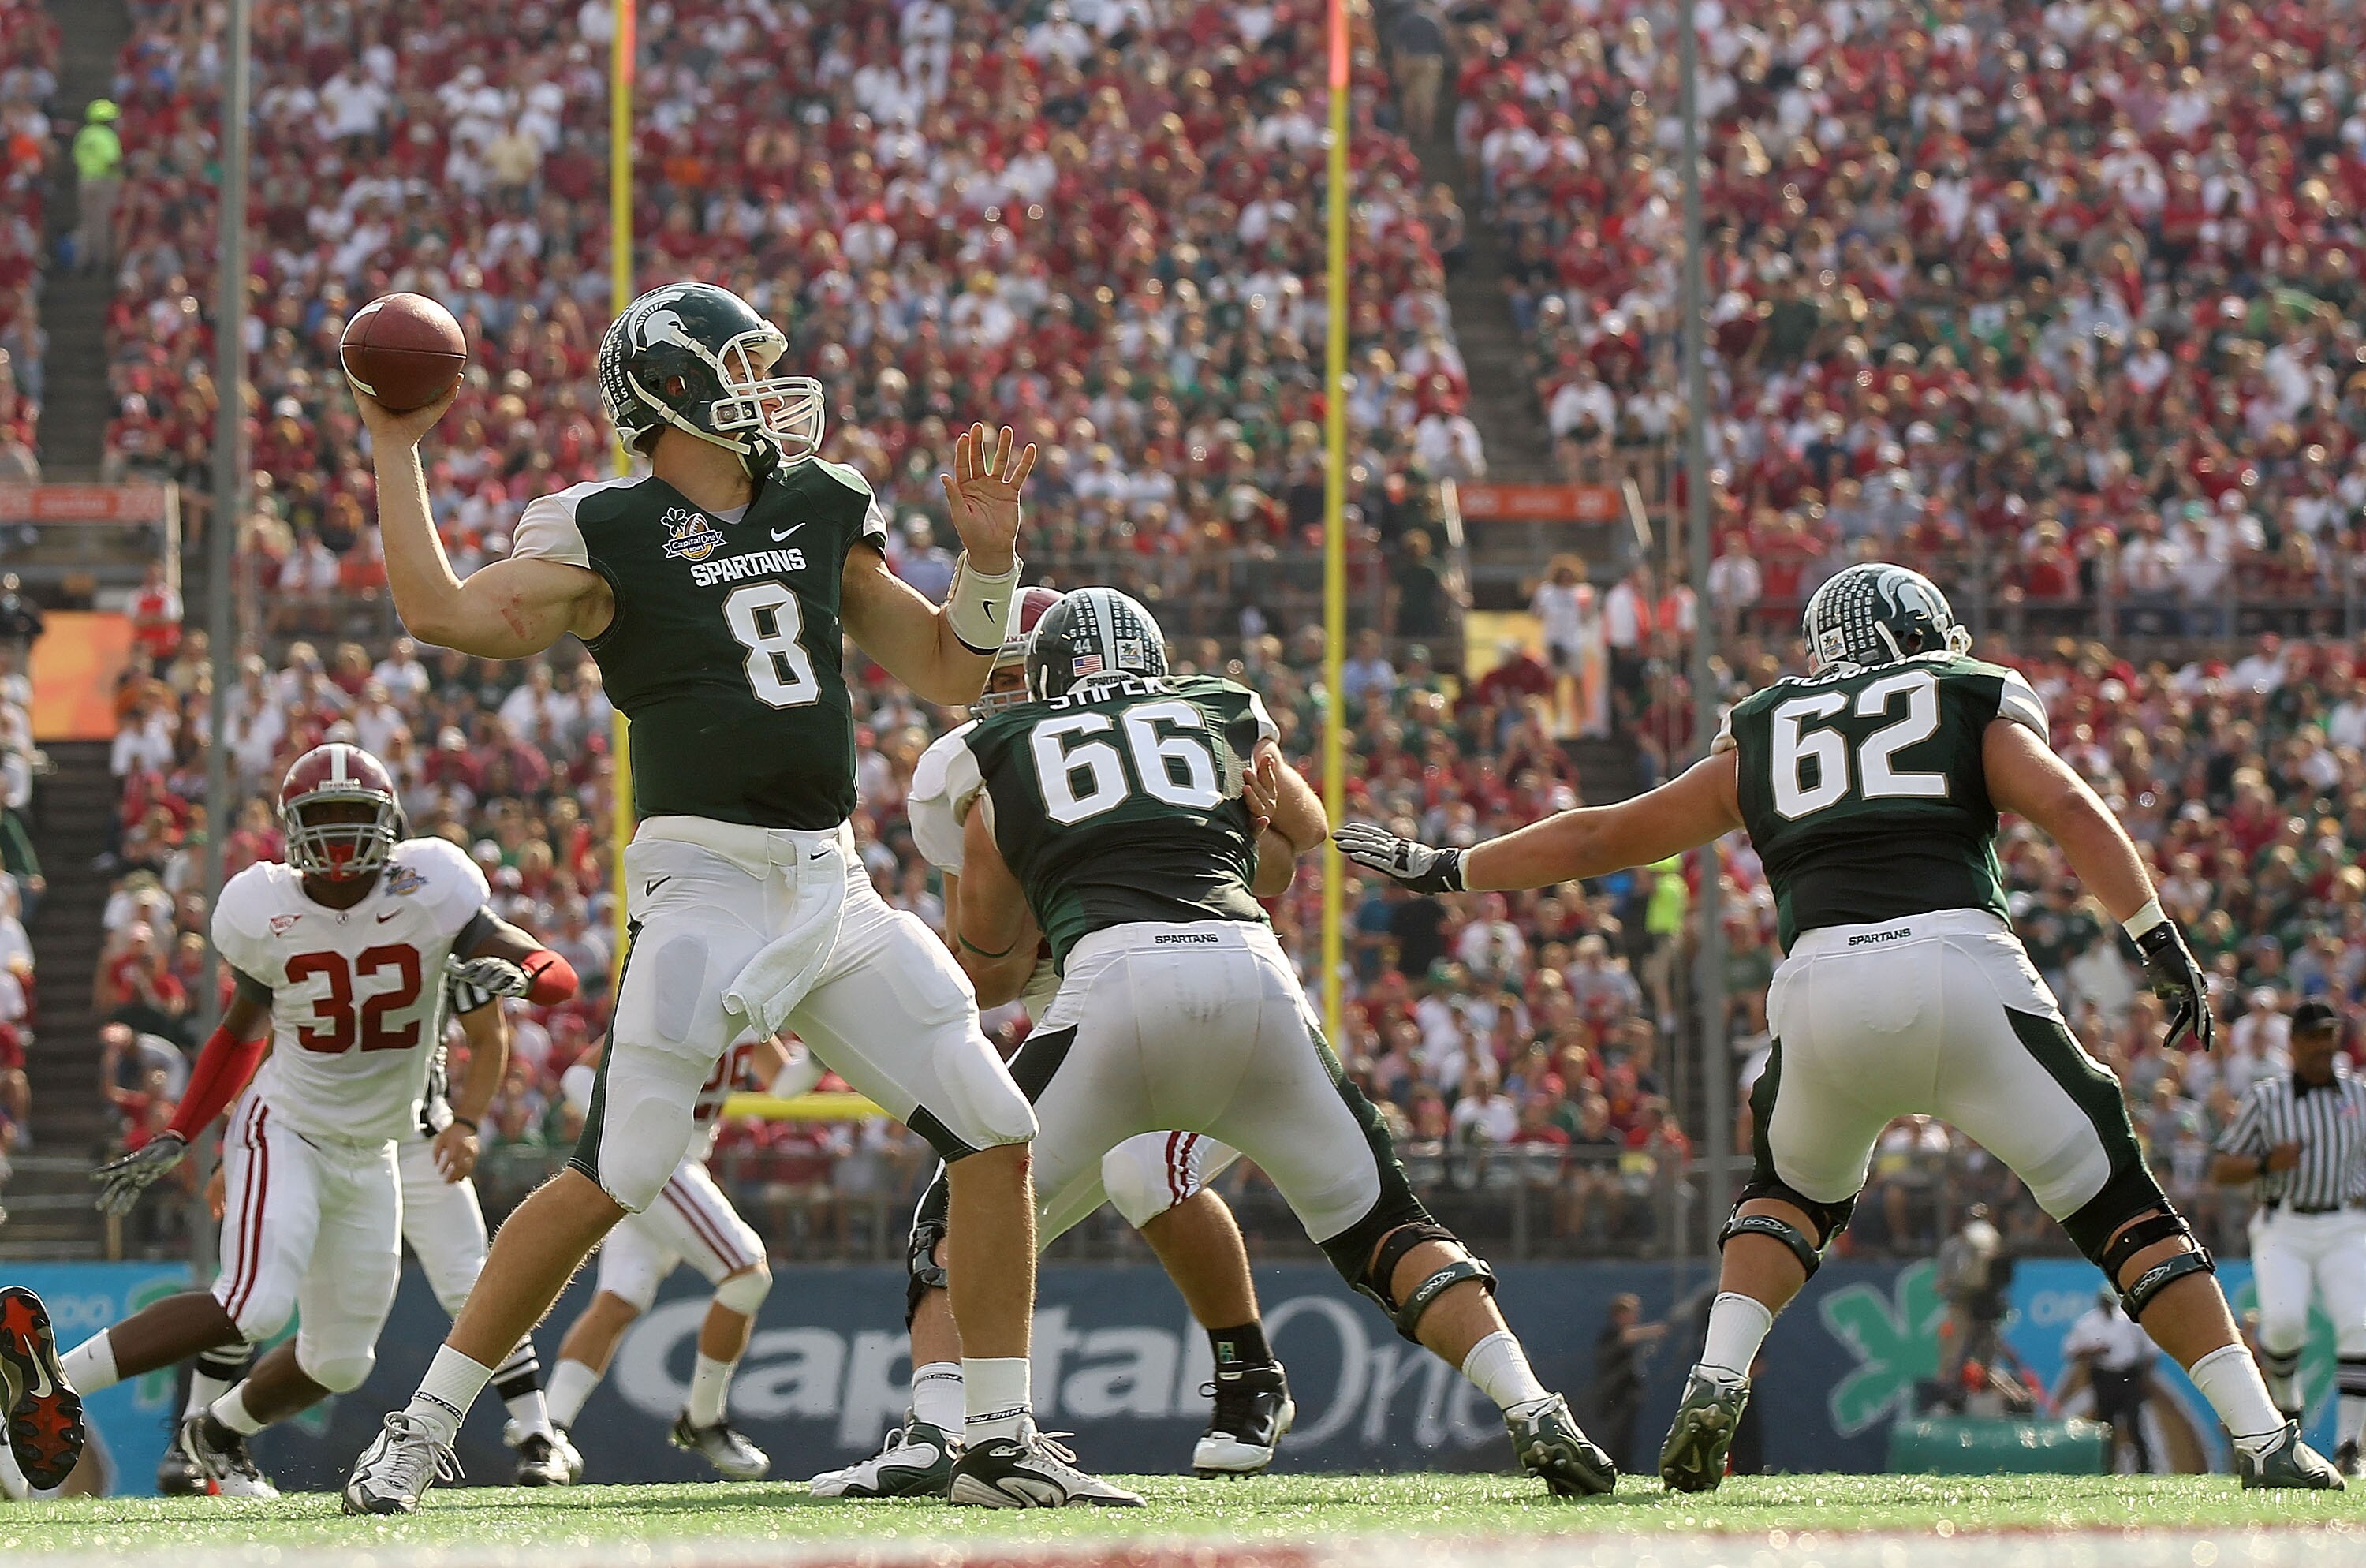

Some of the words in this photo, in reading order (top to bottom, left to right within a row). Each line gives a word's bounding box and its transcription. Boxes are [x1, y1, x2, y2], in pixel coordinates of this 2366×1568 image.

[690, 548, 807, 587] SPARTANS
[721, 579, 823, 710] 8
[1073, 638, 1092, 655] 44
[1028, 698, 1225, 827] 66
[1771, 669, 1950, 822] 62
[1155, 933, 1218, 944] SPARTANS
[1848, 928, 1912, 946] SPARTANS
[285, 943, 421, 1054] 32
